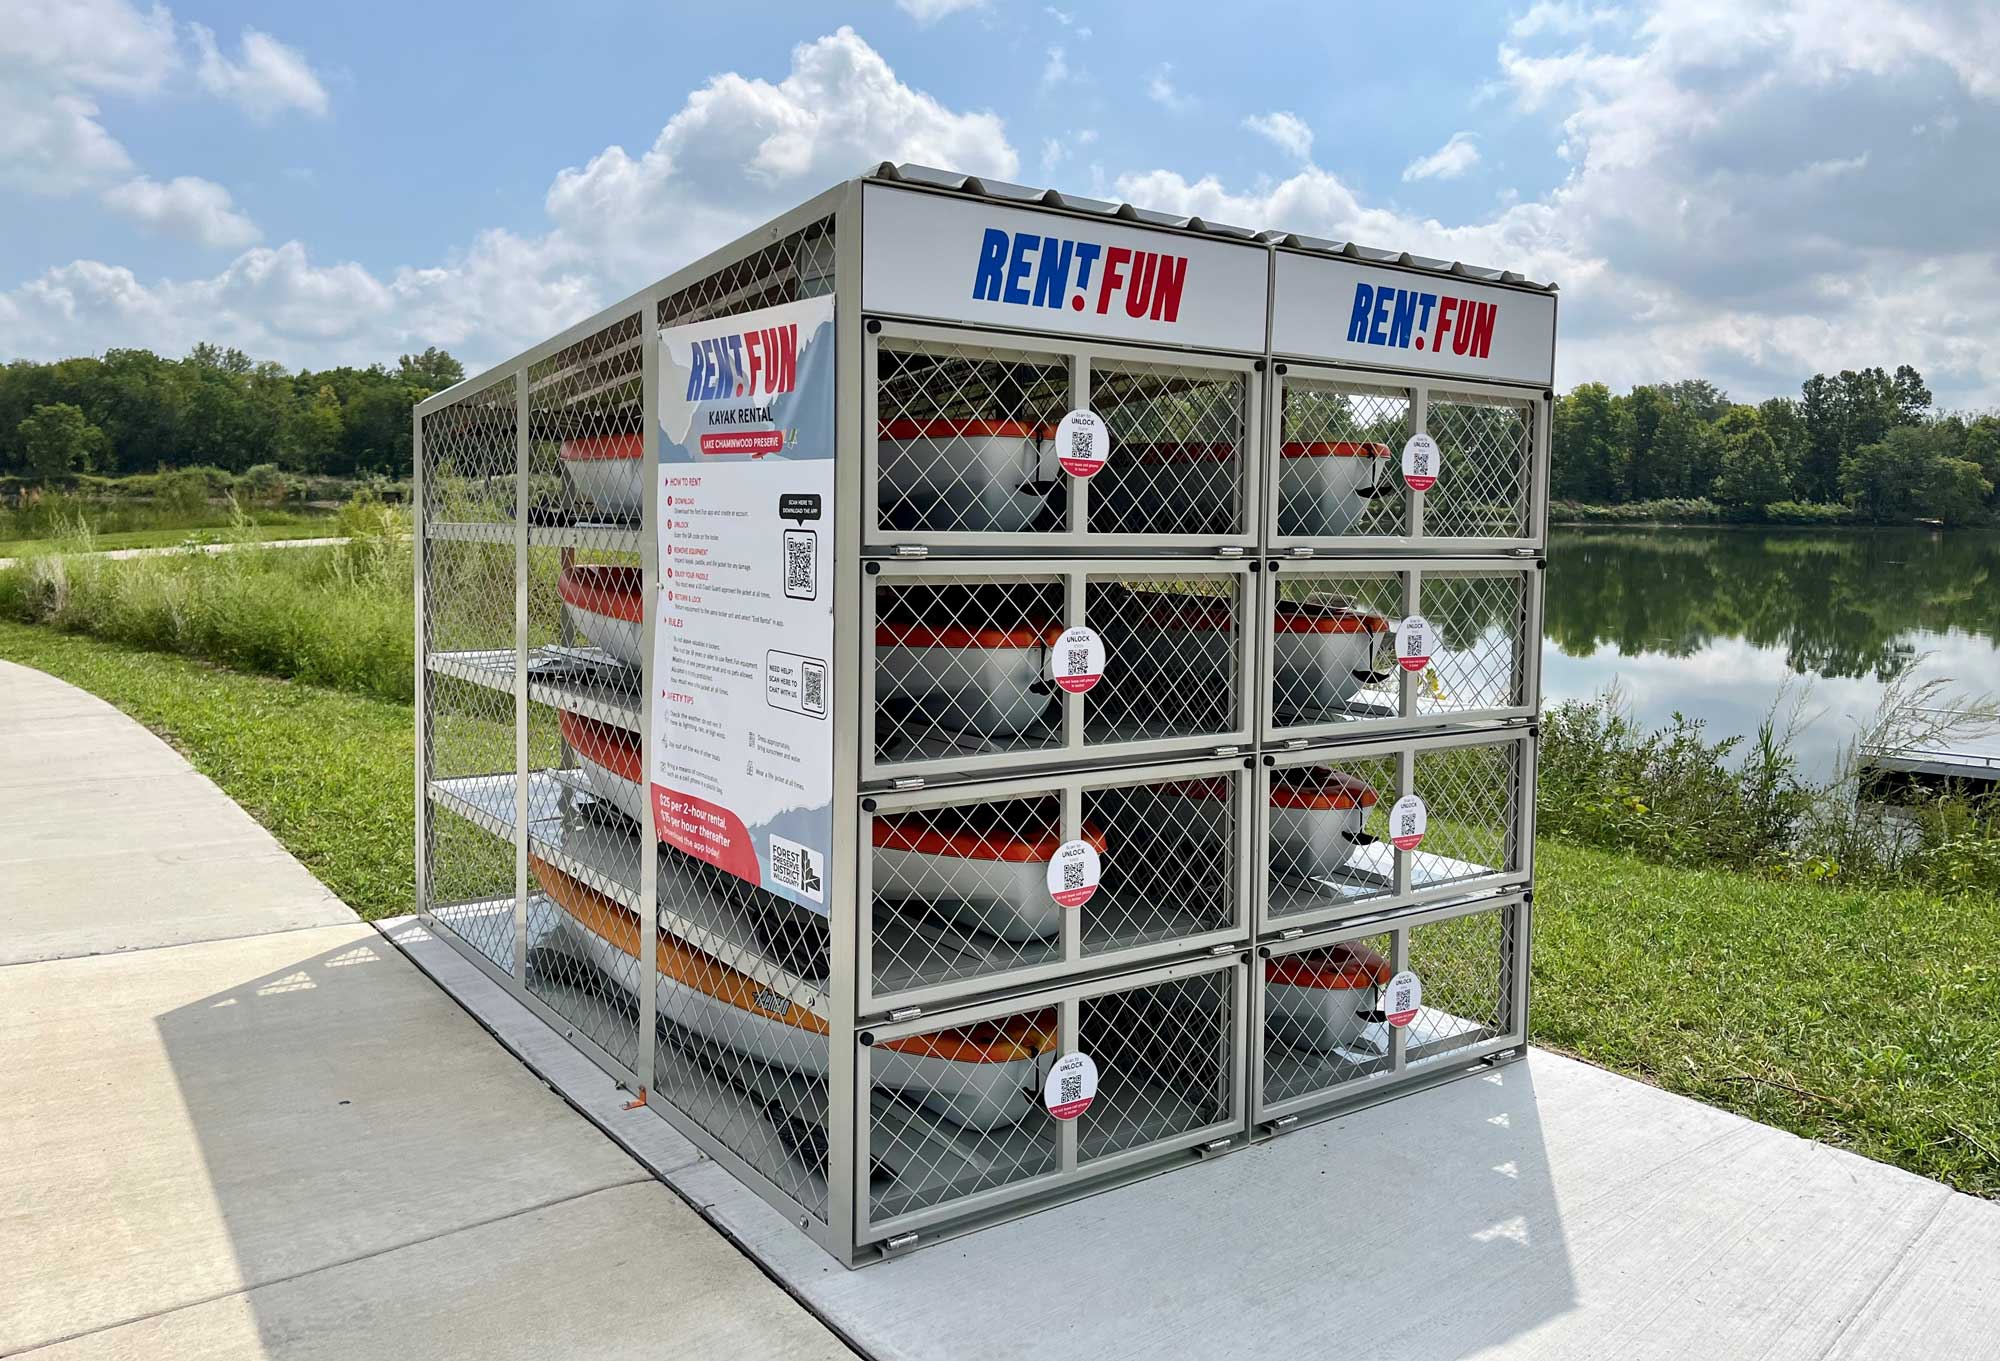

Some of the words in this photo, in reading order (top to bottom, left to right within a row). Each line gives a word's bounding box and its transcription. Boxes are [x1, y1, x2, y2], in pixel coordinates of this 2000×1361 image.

[709, 408, 736, 425] KAYAK
[738, 406, 773, 423] RENTAL
[1071, 418, 1095, 426] UNLOCK
[703, 438, 714, 449] LAKE
[714, 436, 753, 449] CHAMINWOOD
[753, 435, 779, 447] PRESERVE
[670, 478, 681, 487] HOW
[682, 478, 688, 487] TO
[689, 477, 702, 487] RENT
[668, 617, 683, 628] RULES
[1066, 635, 1090, 643] UNLOCK
[769, 664, 780, 673] NEED
[781, 666, 793, 676] HELP?
[769, 675, 780, 683] SCAN
[780, 677, 791, 686] HERE
[769, 686, 780, 694] CHAT
[780, 688, 791, 697] WITH
[684, 695, 694, 705] TIPS
[659, 793, 671, 808] $25
[671, 800, 682, 812] per
[683, 802, 707, 819] 2-hour
[707, 813, 727, 831] rental,
[671, 816, 680, 828] per
[681, 818, 698, 834] hour
[699, 824, 731, 848] thereafter
[683, 836, 693, 847] the
[693, 841, 705, 853] app
[772, 844, 800, 863] FOREST
[1061, 848, 1086, 858] UNLOCK
[772, 855, 800, 872] PRESERVE
[773, 862, 800, 881] DISTRICT
[1060, 1061, 1084, 1071] UNLOCK
